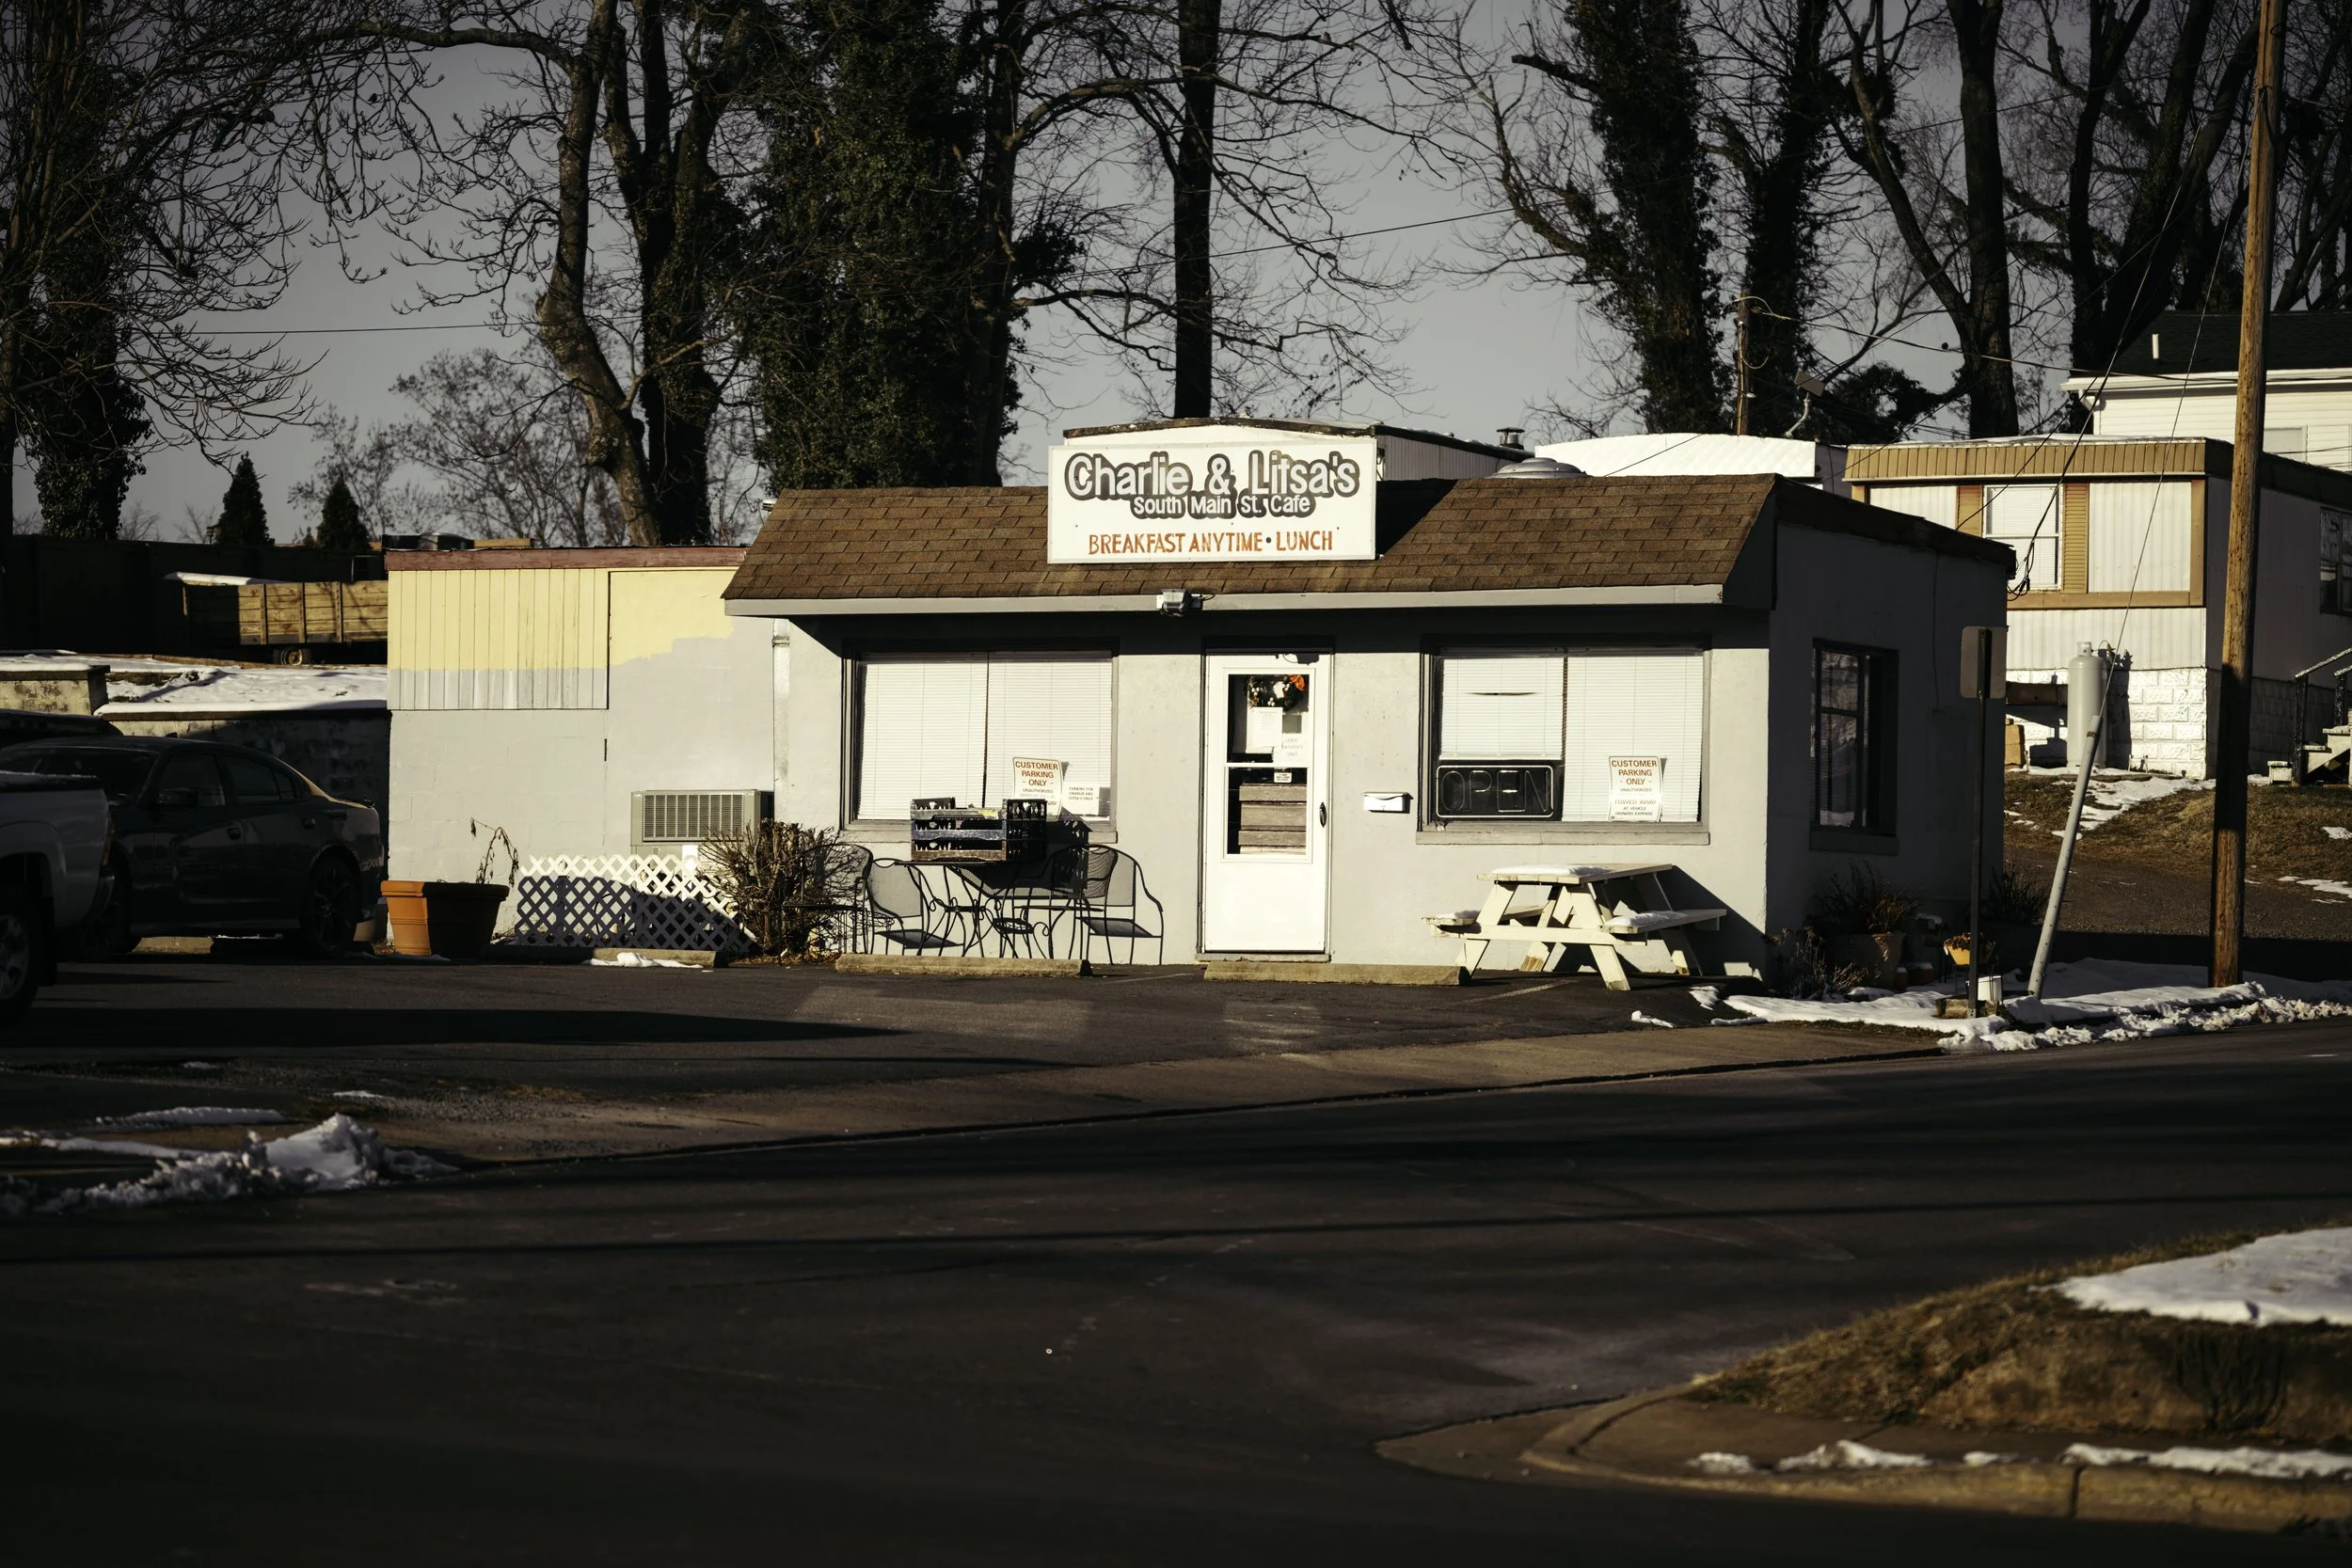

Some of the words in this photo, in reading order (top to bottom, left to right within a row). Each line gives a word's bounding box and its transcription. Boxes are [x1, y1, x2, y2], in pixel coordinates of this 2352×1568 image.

[1067, 452, 1190, 499] Charlie
[1208, 455, 1232, 497] &
[1250, 451, 1358, 497] Litsa's
[1134, 495, 1183, 515] South
[1189, 495, 1232, 515] Main
[1241, 495, 1263, 515] St.
[1271, 494, 1311, 514] Cafe
[1089, 532, 1186, 555] BREAKFAST
[1189, 531, 1263, 553] ANYTIME
[1276, 531, 1333, 551] LUNCH
[1015, 761, 1058, 770] CUSTOMER
[1441, 769, 1549, 813] OPEN
